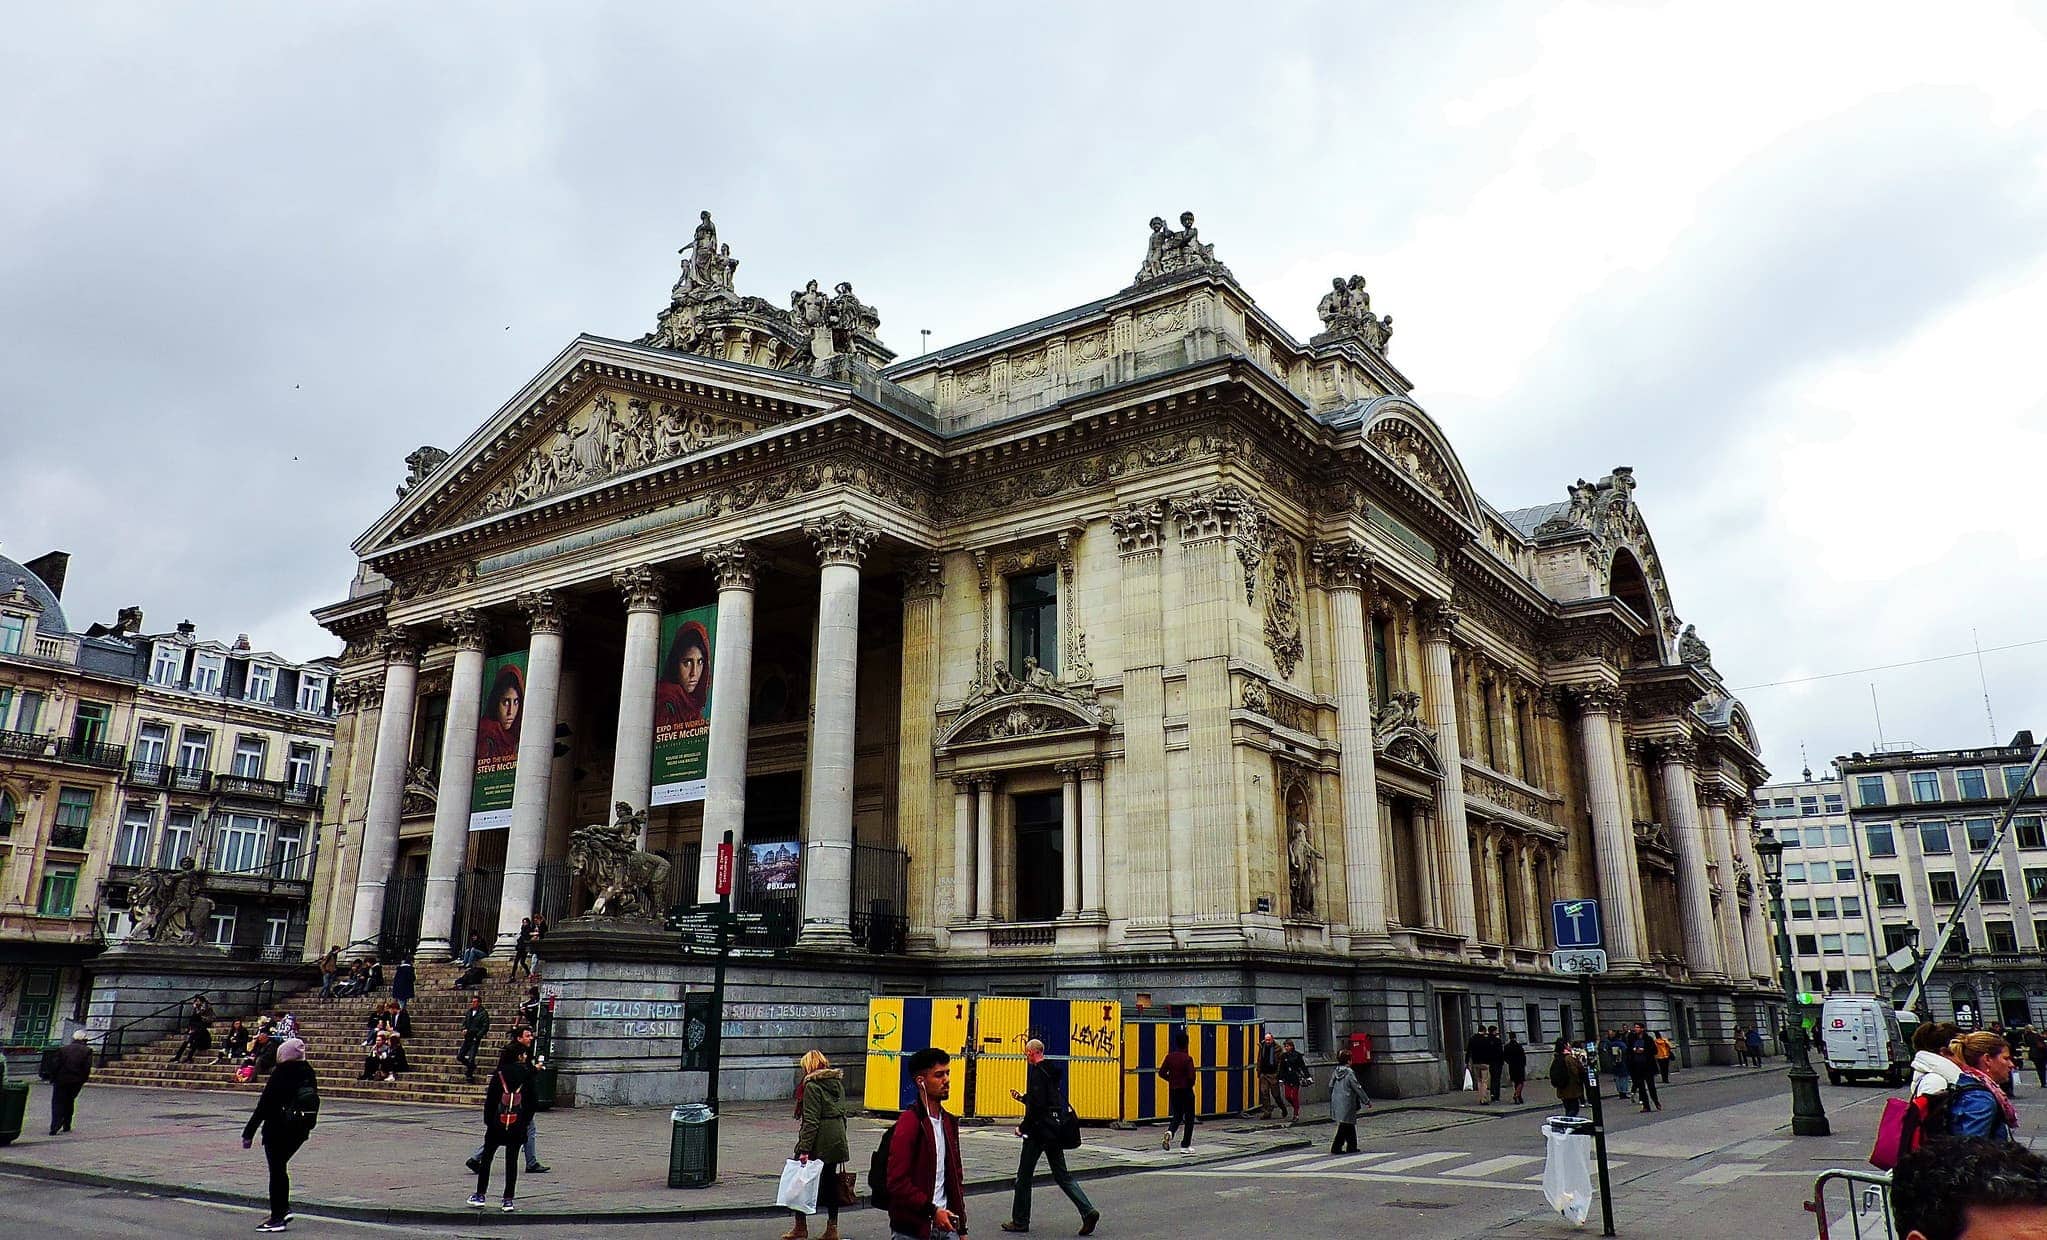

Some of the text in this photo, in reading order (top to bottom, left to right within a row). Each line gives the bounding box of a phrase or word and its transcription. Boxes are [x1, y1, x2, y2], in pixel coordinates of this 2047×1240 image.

[656, 725, 671, 734] EXPO
[656, 732, 678, 743] STEVE
[477, 764, 496, 774] STEVE
[591, 1001, 640, 1017] JEZUS
[778, 1005, 807, 1017] JESUS
[810, 1006, 837, 1017] SAVES
